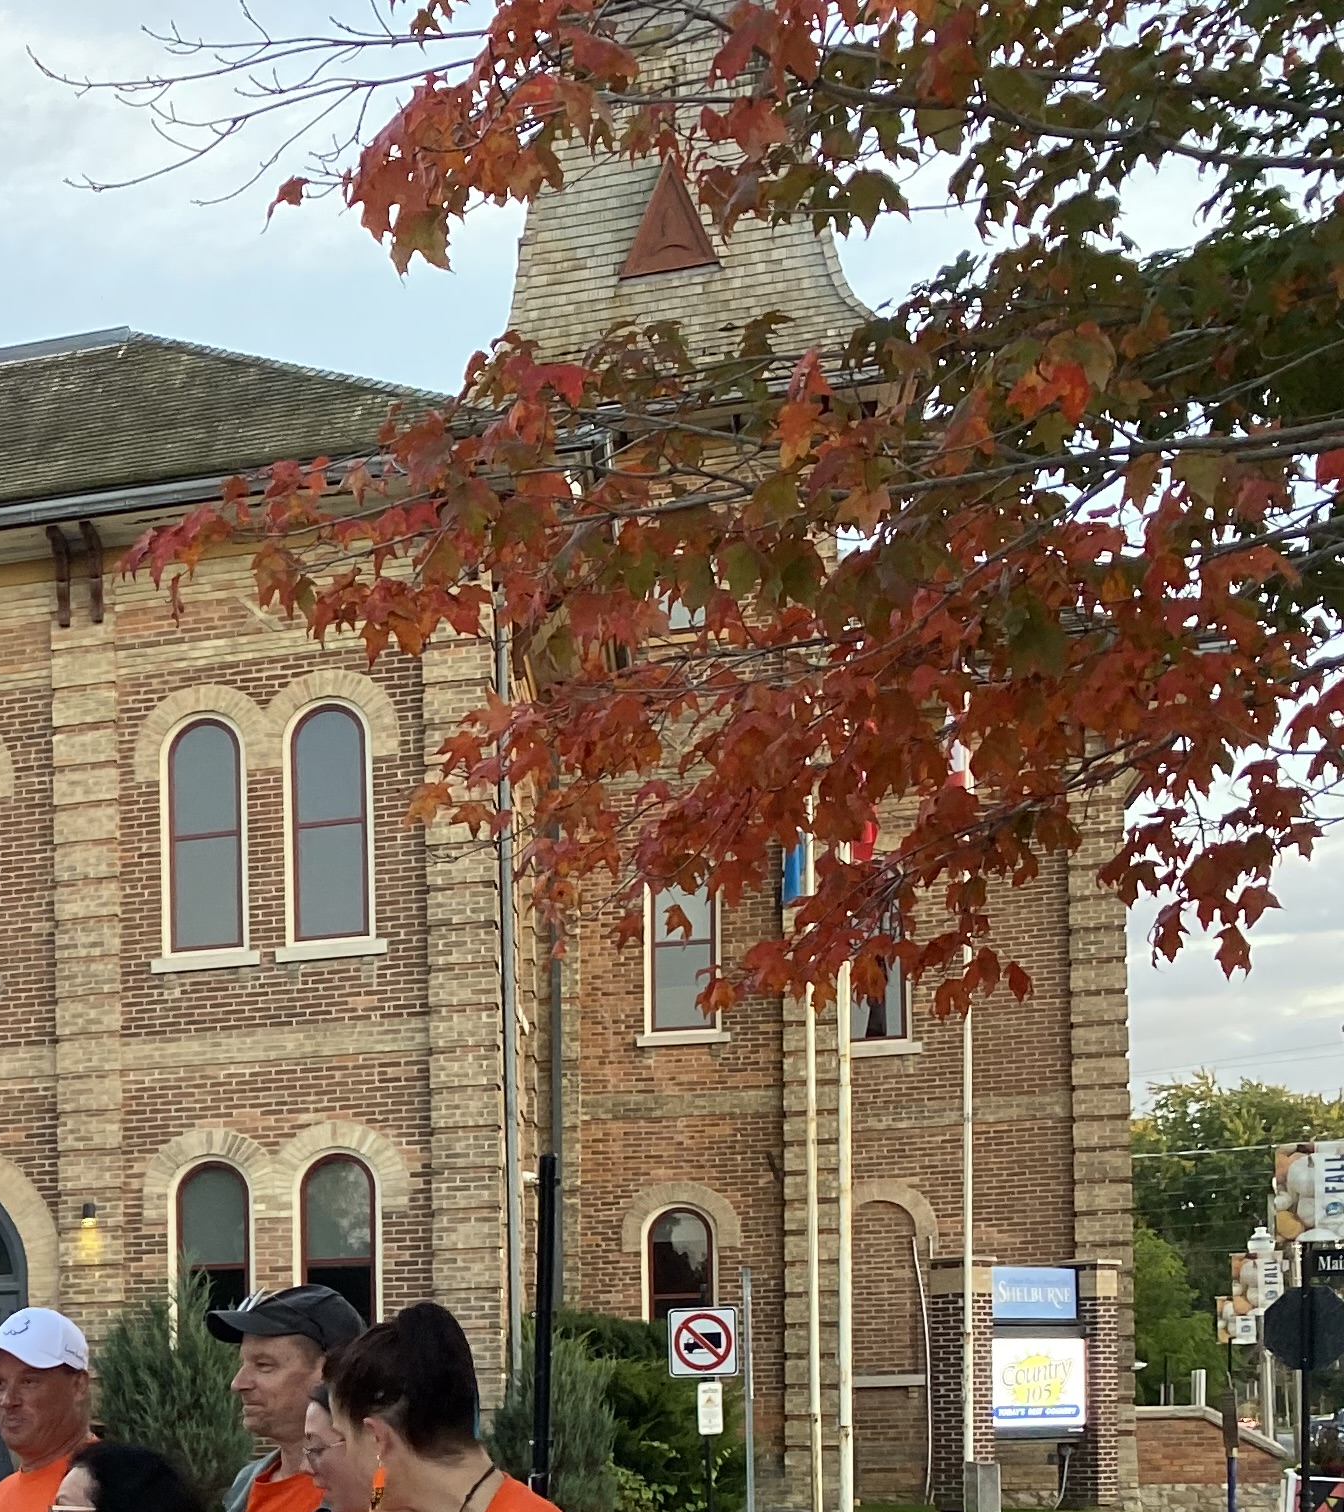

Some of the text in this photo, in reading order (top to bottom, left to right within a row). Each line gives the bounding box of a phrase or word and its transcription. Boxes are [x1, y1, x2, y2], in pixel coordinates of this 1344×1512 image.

[1264, 1259, 1279, 1285] FALL
[1318, 1254, 1344, 1271] Mai
[998, 1280, 1072, 1309] SHELBURNE
[1001, 1358, 1073, 1387] Country
[1025, 1384, 1052, 1403] 105
